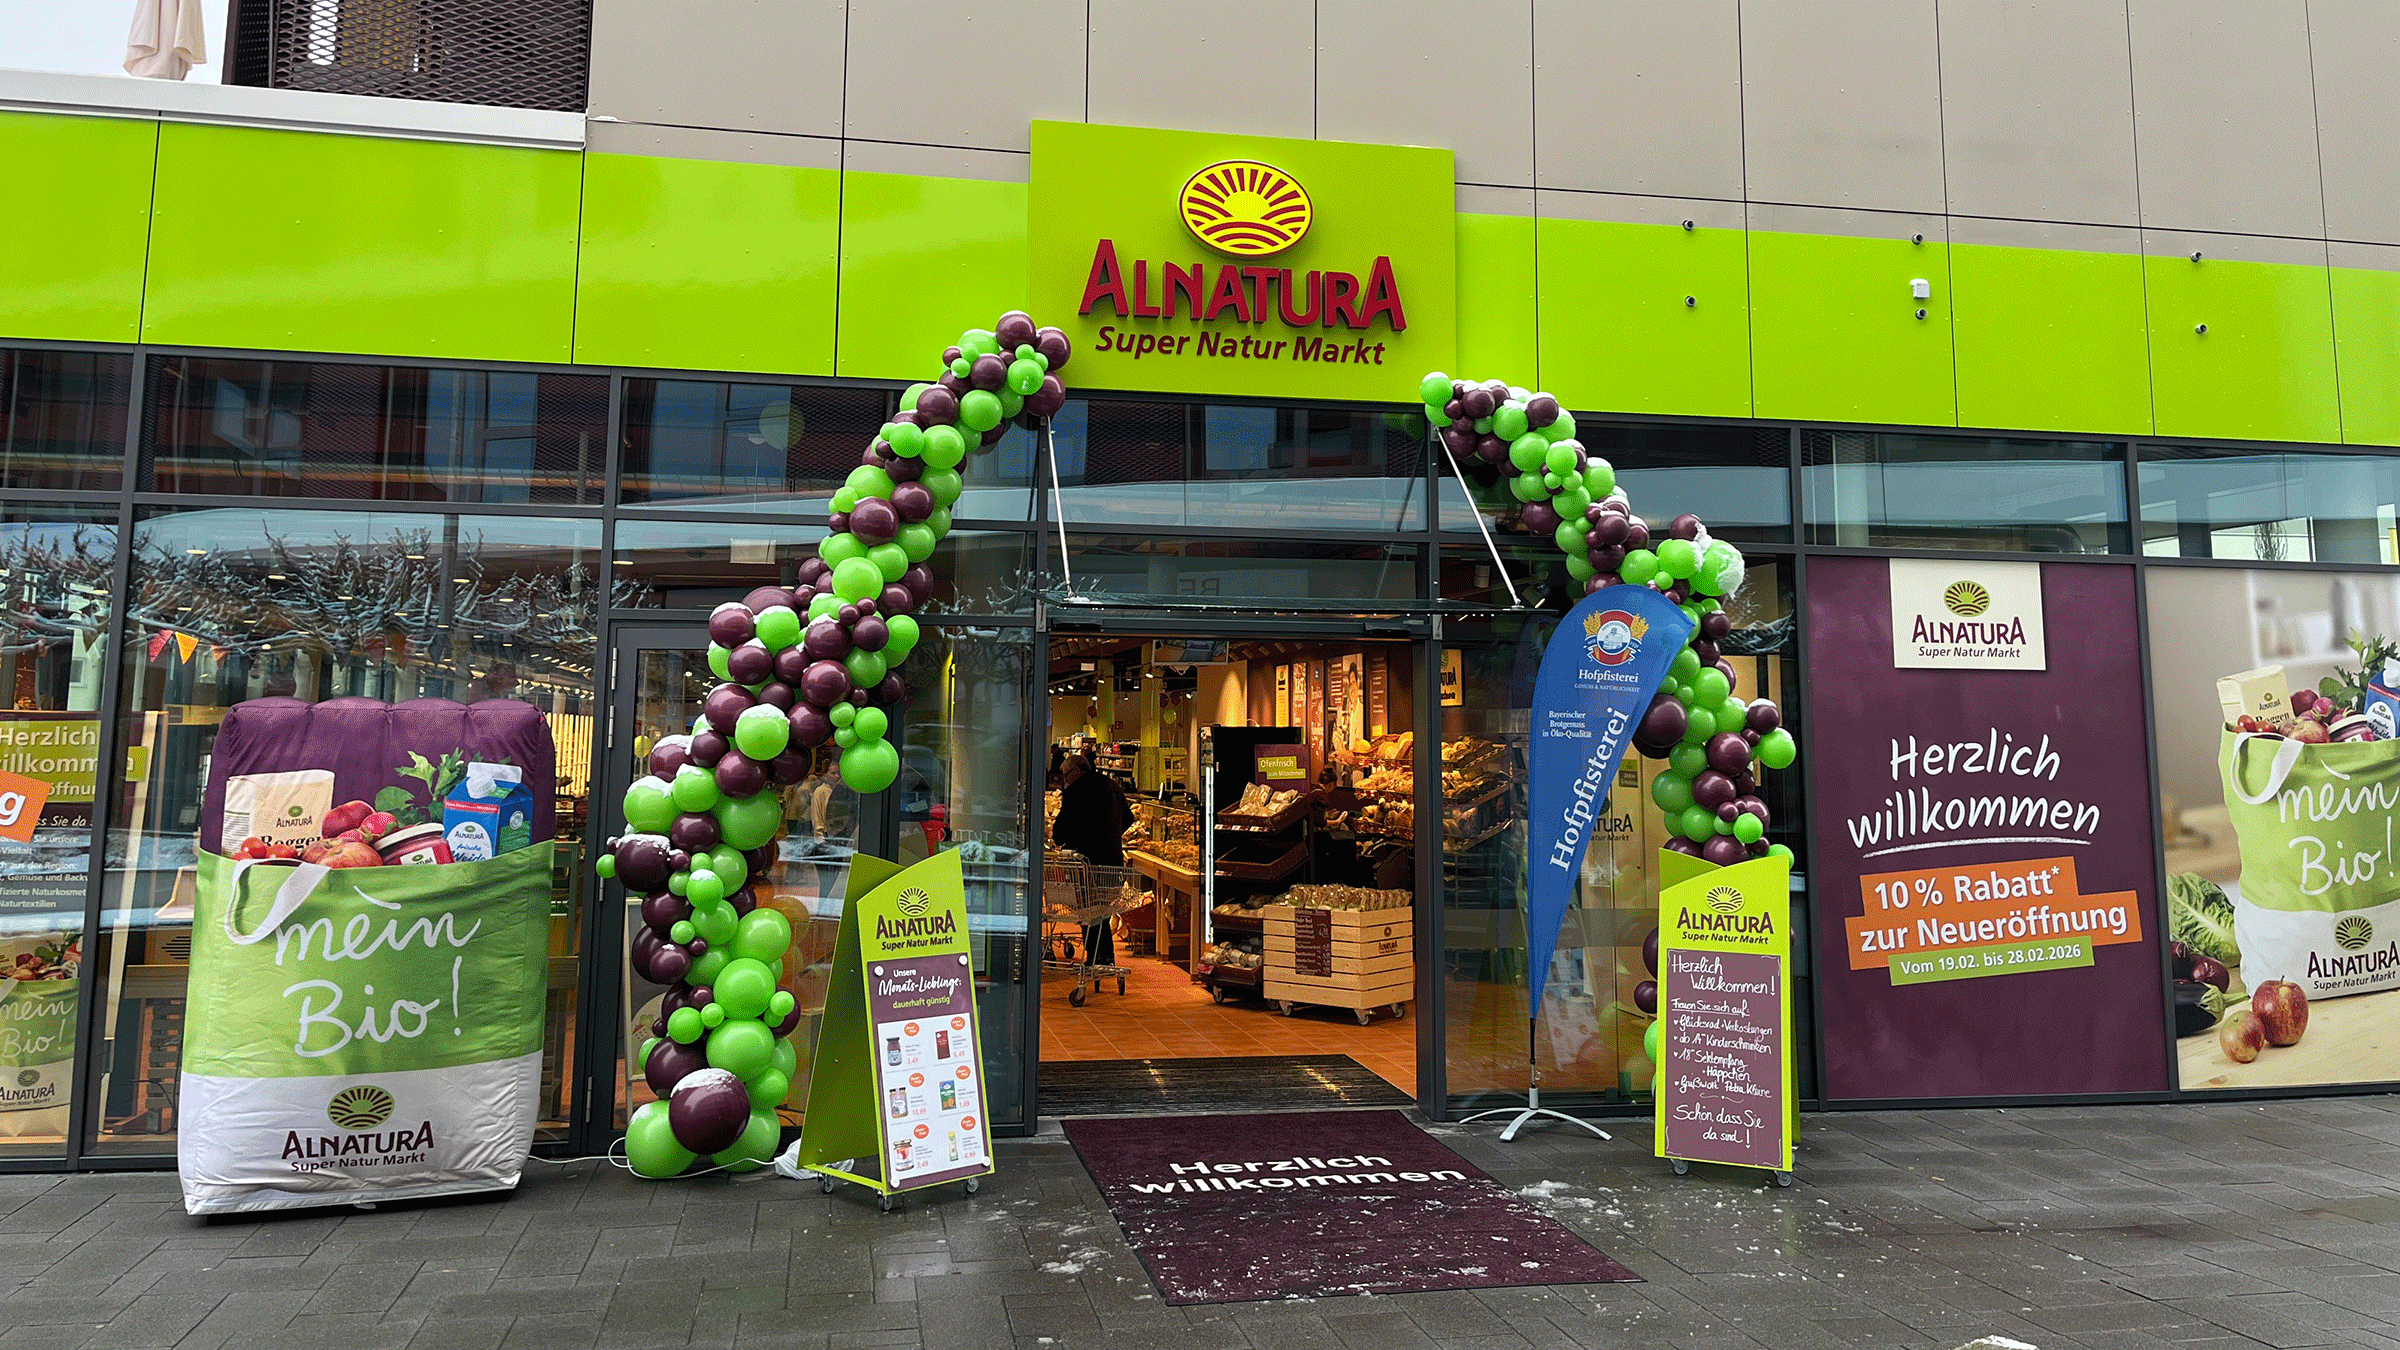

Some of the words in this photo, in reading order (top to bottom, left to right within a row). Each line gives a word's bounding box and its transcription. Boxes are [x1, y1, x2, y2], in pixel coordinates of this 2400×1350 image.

[1078, 238, 1408, 332] ALNATURA
[1096, 325, 1190, 360] Super
[1196, 331, 1286, 360] Natur
[1292, 336, 1386, 364] Markt
[1911, 614, 2026, 646] ALNATURA
[1918, 645, 1951, 660] Super
[1953, 646, 1986, 658] Natur
[1987, 646, 2021, 659] Markt
[1578, 669, 1639, 683] Hofpfisterei
[1548, 710, 1586, 719] Bayerischer
[1549, 720, 1586, 730] Brotgenuss
[1542, 729, 1549, 737] in
[1550, 729, 1592, 739] Öko-Qualität
[1890, 726, 2062, 782] Herzlich
[1549, 706, 1630, 871] Hofpfisterei
[2277, 759, 2400, 824] mein
[50, 815, 69, 827] Sie
[72, 815, 87, 827] da
[276, 815, 313, 829] ALNATURA
[1847, 786, 2101, 849] willkommen
[2289, 816, 2395, 897] Bio!
[45, 872, 62, 881] und
[1874, 879, 1910, 912] 10
[1914, 877, 1944, 907] %
[275, 885, 482, 966] mein
[876, 909, 957, 939] ALNATURA
[1676, 906, 1774, 935] ALNATURA
[1860, 925, 1909, 953] zur
[1917, 903, 2128, 948] Neueröffnung
[881, 941, 905, 952] Super
[906, 938, 928, 949] Natur
[930, 935, 953, 946] Markt
[1682, 931, 1709, 944] Super
[1710, 933, 1738, 943] Natur
[1739, 934, 1769, 945] Markt
[1671, 954, 1724, 975] Herzlich
[1901, 959, 1934, 976] Vom
[1939, 954, 1980, 972] 19.02.
[1983, 950, 2004, 968] bis
[2007, 943, 2082, 966] 28.02.2026
[2307, 941, 2400, 978] ALNATURA
[893, 968, 917, 978] Unsere
[2313, 980, 2341, 991] Super
[2343, 976, 2370, 988] Natur
[2370, 970, 2396, 983] Markt
[878, 975, 962, 997] Monats-Lieblinge:
[283, 955, 463, 1058] Bio!
[892, 998, 925, 1010] dauerhaft
[926, 995, 951, 1008] günstig
[1671, 998, 1696, 1010] Freuen
[1696, 1000, 1711, 1011] Sie
[1712, 1000, 1730, 1012] sich
[1679, 1032, 1690, 1044] ab
[1706, 1065, 1751, 1083] Häppchen
[1716, 1107, 1743, 1125] dass
[1743, 1109, 1765, 1129] Sie
[281, 1120, 434, 1160] ALNATURA
[1702, 1126, 1718, 1140] da
[291, 1160, 335, 1173] Super
[339, 1156, 380, 1168] Natur
[383, 1152, 425, 1166] Markt
[1168, 1153, 1393, 1175] Herzlich
[1130, 1169, 1467, 1195] willkommen
